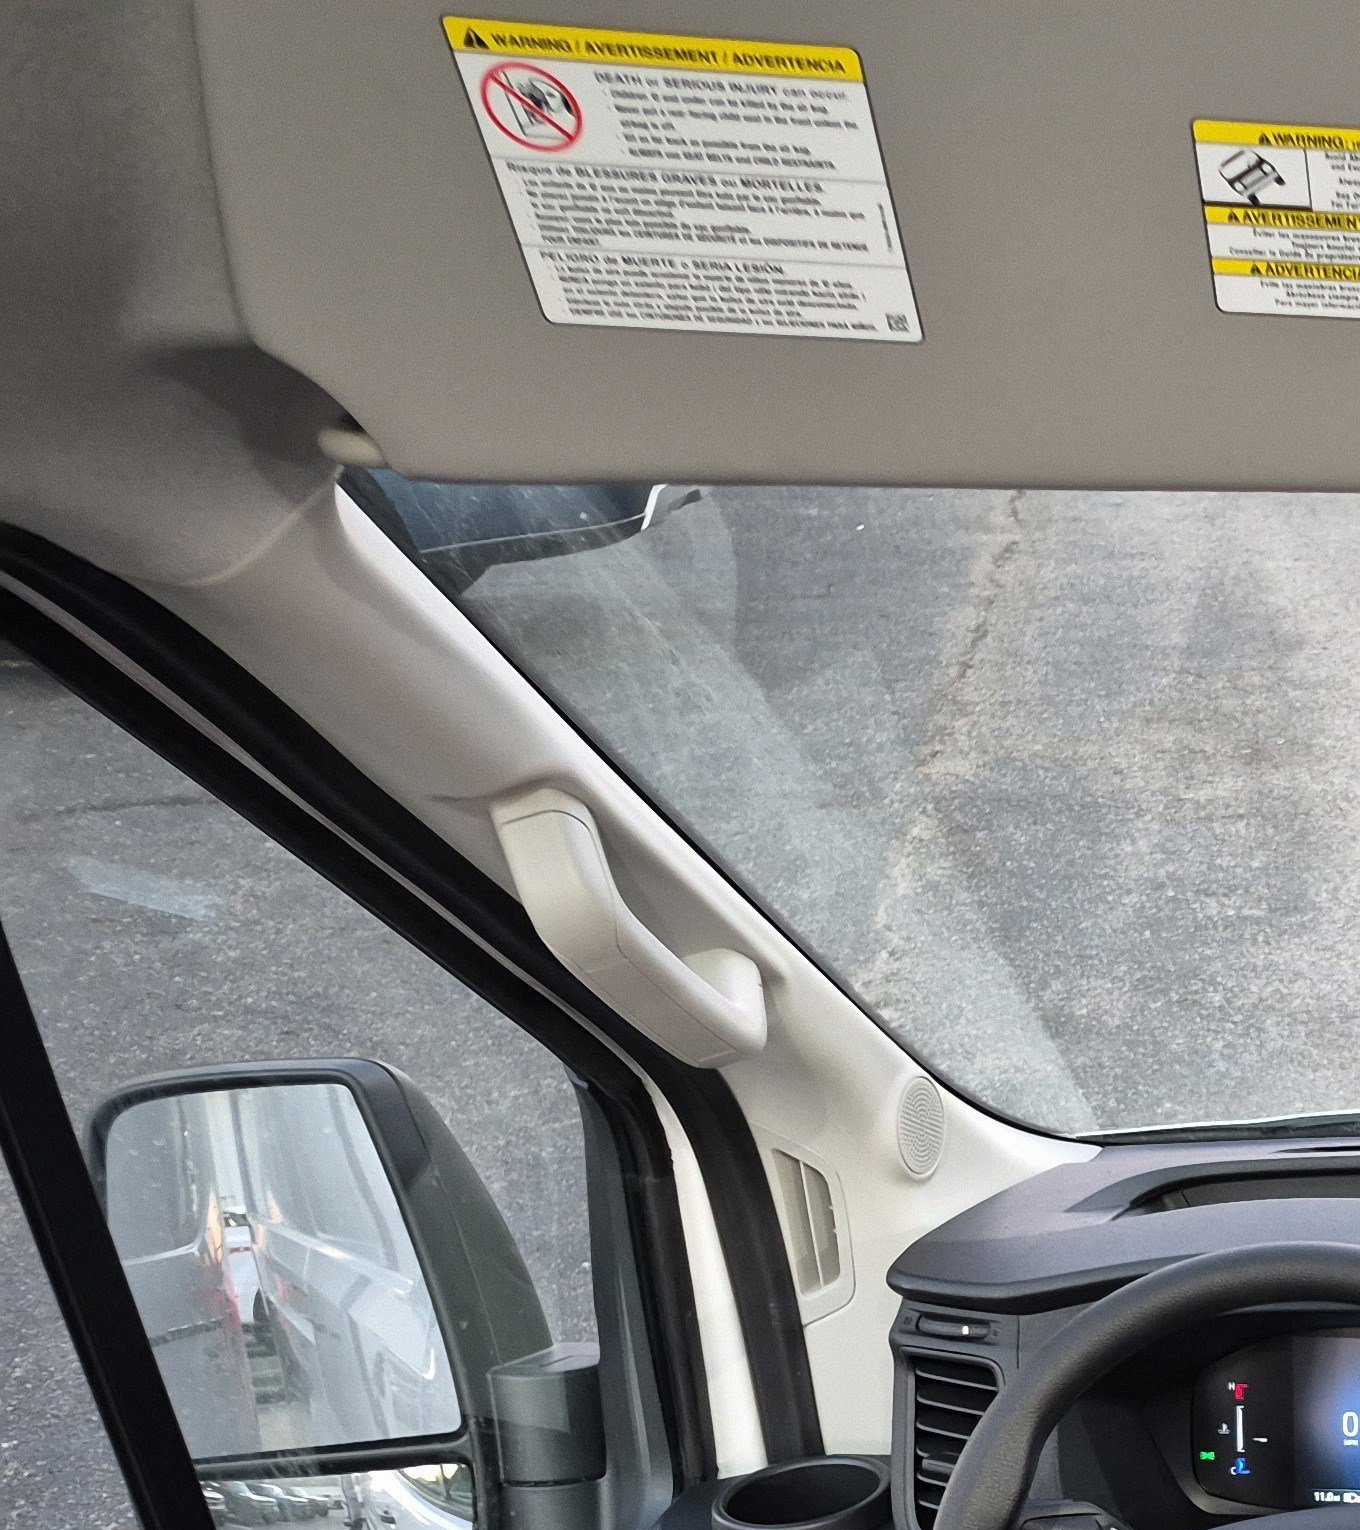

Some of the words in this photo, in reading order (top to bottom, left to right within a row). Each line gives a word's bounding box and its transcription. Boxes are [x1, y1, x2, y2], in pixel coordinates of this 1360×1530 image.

[490, 32, 573, 53] WARNING
[583, 40, 719, 64] AVERTISSEMENT
[730, 51, 846, 74] ADVERTENCIA
[1342, 1411, 1359, 1437] 0
